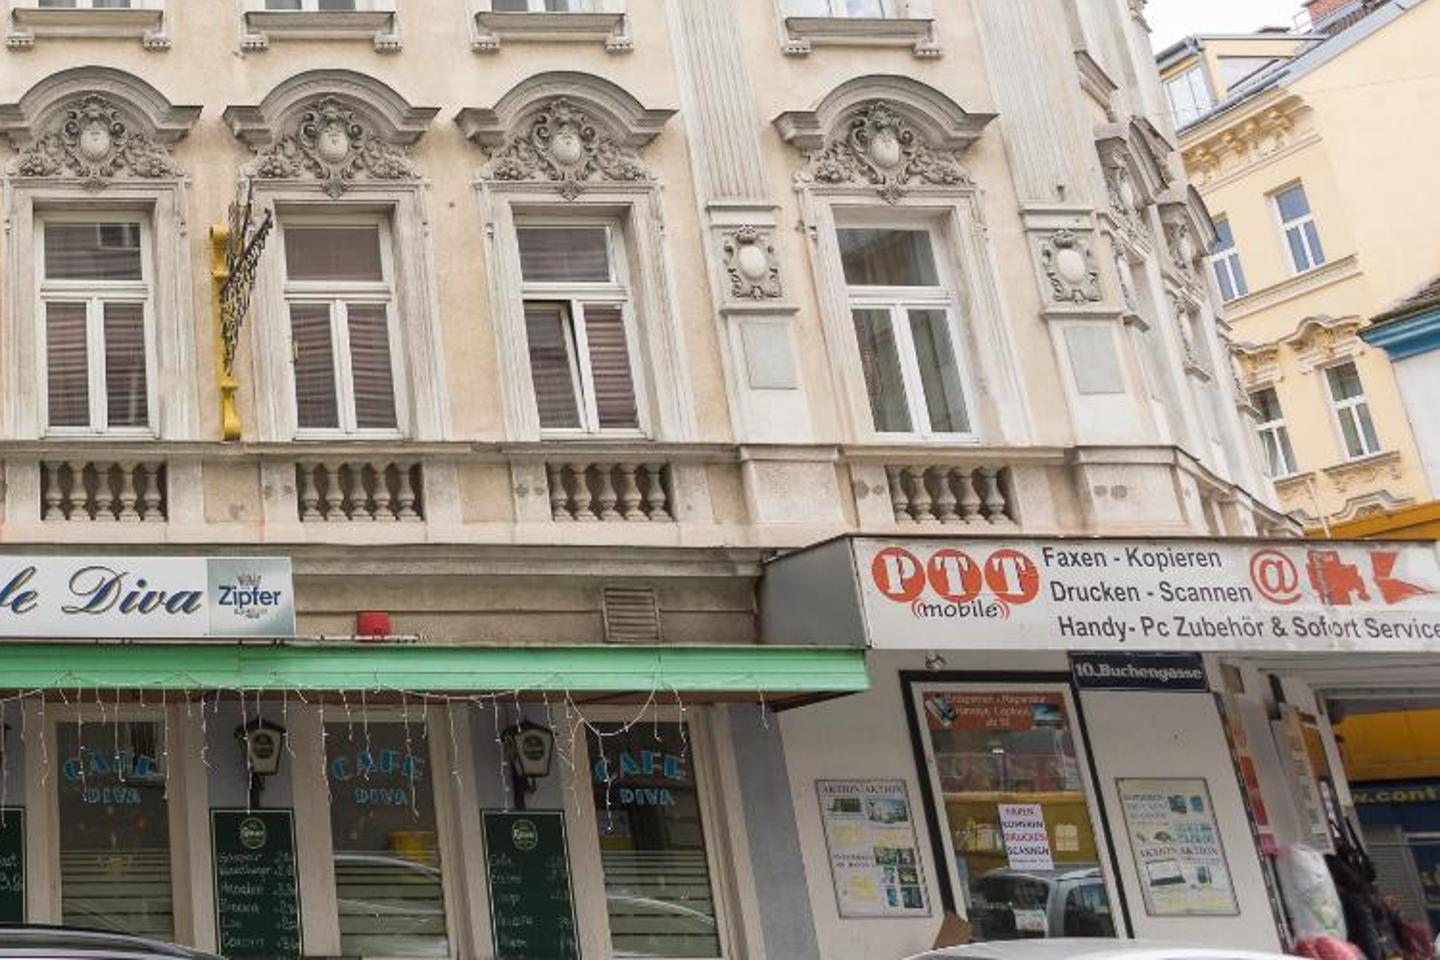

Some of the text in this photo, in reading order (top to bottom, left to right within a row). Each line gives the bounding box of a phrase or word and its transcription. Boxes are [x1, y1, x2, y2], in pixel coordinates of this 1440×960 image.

[1041, 547, 1107, 567] Faxen
[1125, 547, 1222, 572] Kopieren
[878, 552, 1030, 598] PTT
[61, 565, 203, 614] Diva
[217, 585, 282, 609] Zipfer
[1050, 581, 1141, 602] Drucken
[1160, 581, 1253, 602] Scannen
[923, 599, 998, 617] mobile
[1141, 616, 1170, 637] Pc
[1173, 615, 1264, 638] Zubehör
[1271, 616, 1288, 636] &
[1364, 618, 1440, 639] Service
[1100, 664, 1202, 682] Buchengasse
[331, 749, 424, 781] CAFE
[594, 749, 688, 783] CAFE
[87, 788, 142, 803] DIVA
[354, 788, 408, 805] DIVA
[620, 788, 676, 806] DIVA
